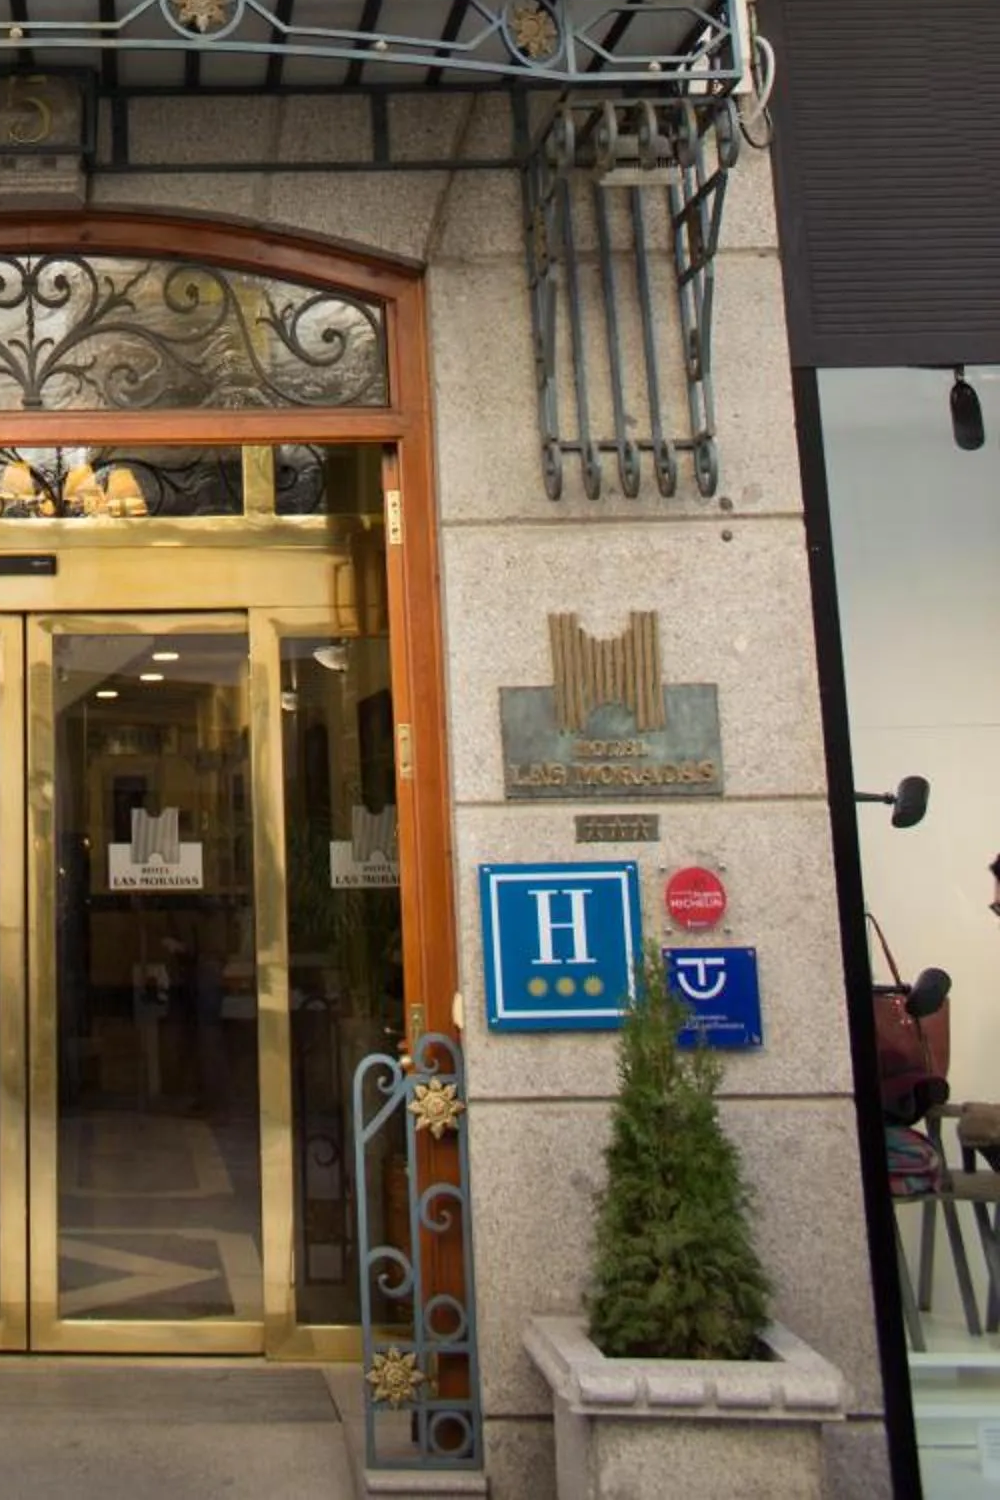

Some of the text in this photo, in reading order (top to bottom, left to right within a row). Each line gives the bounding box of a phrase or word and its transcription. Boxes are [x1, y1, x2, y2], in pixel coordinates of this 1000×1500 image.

[509, 759, 716, 786] LAS MORADAS
[527, 888, 598, 965] H
